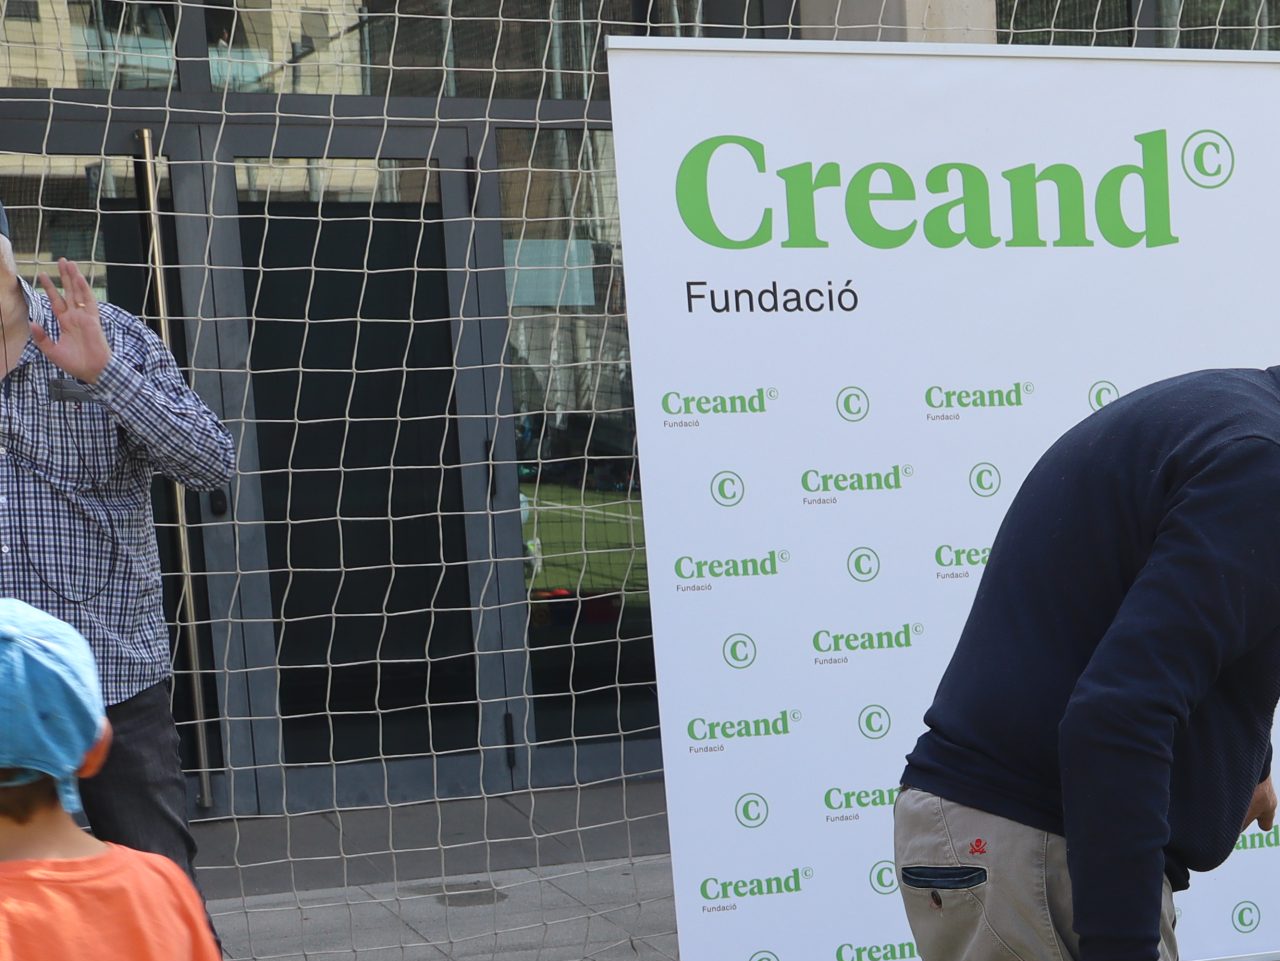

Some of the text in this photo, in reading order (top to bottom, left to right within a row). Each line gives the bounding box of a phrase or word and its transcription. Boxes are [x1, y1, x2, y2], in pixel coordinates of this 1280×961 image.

[685, 279, 859, 313] Fundació
[926, 413, 961, 421] Fundació
[663, 419, 700, 428] Fundació
[802, 496, 838, 505] Fundació
[935, 544, 993, 567] Crea
[936, 570, 970, 580] Fundació
[676, 583, 713, 593] Fundació
[814, 656, 849, 665] Fundació
[688, 744, 725, 754] Fundació
[824, 786, 902, 810] Crean
[825, 813, 860, 823] Fundació
[701, 903, 737, 913] Fundació
